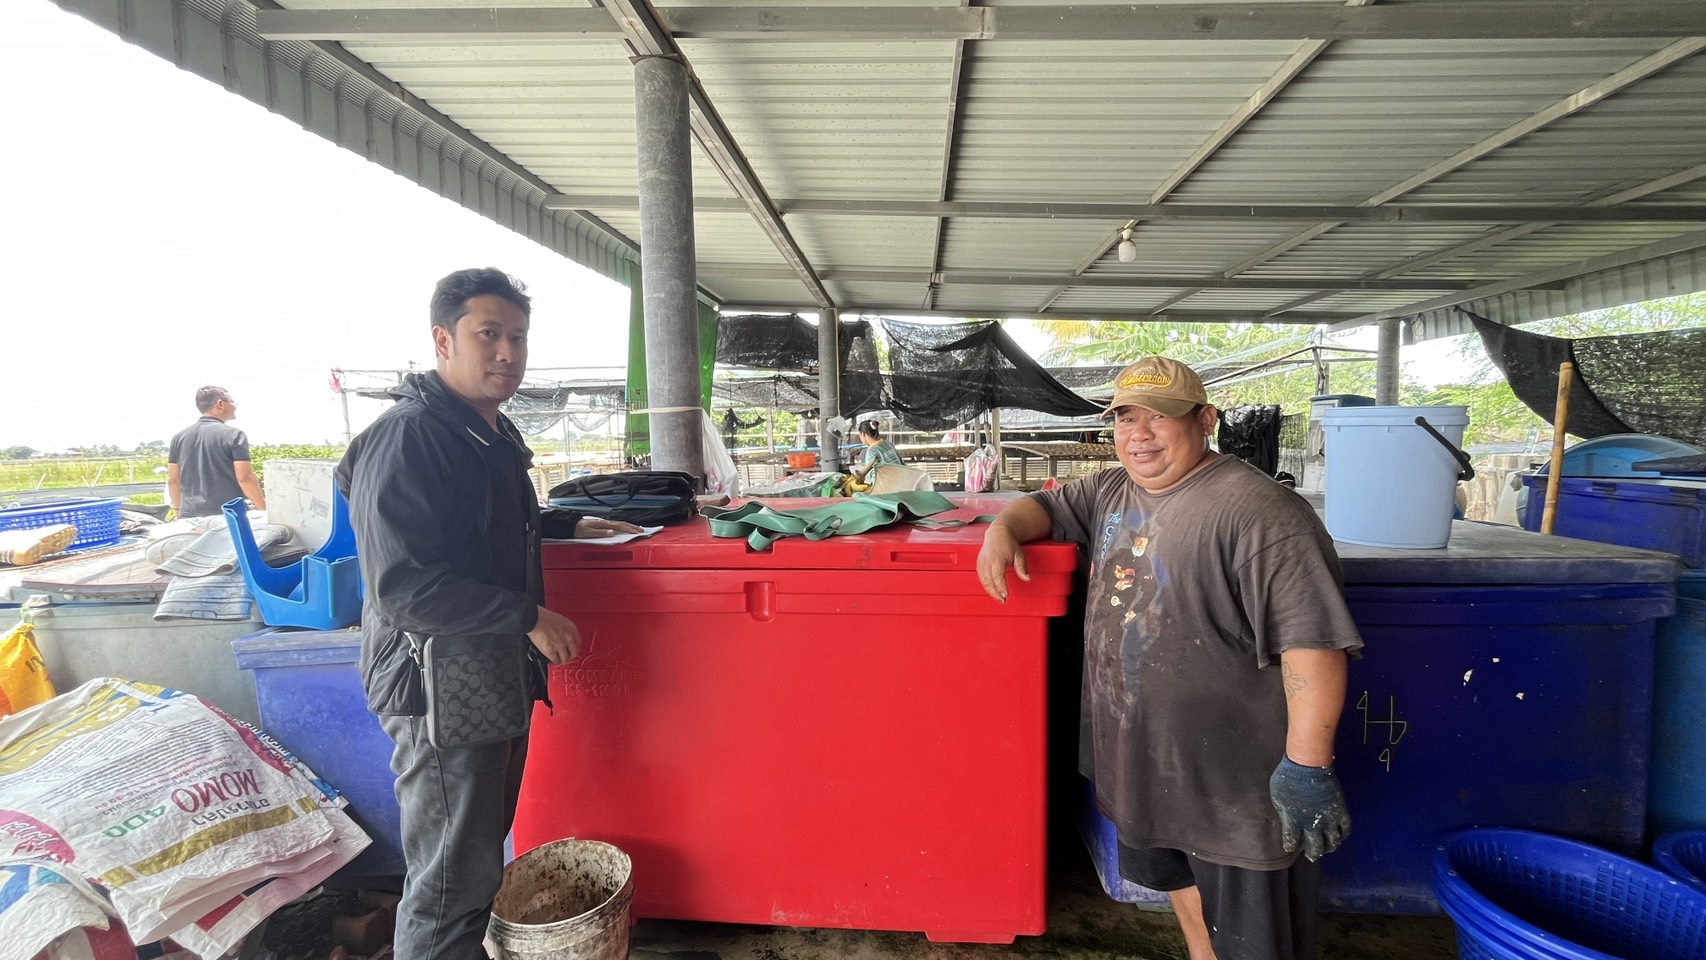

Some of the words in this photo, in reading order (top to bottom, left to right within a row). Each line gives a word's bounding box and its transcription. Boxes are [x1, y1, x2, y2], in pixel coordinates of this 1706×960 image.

[171, 769, 262, 813] MOMO
[102, 805, 166, 838] 400
[192, 798, 271, 826] อาหารปลา
